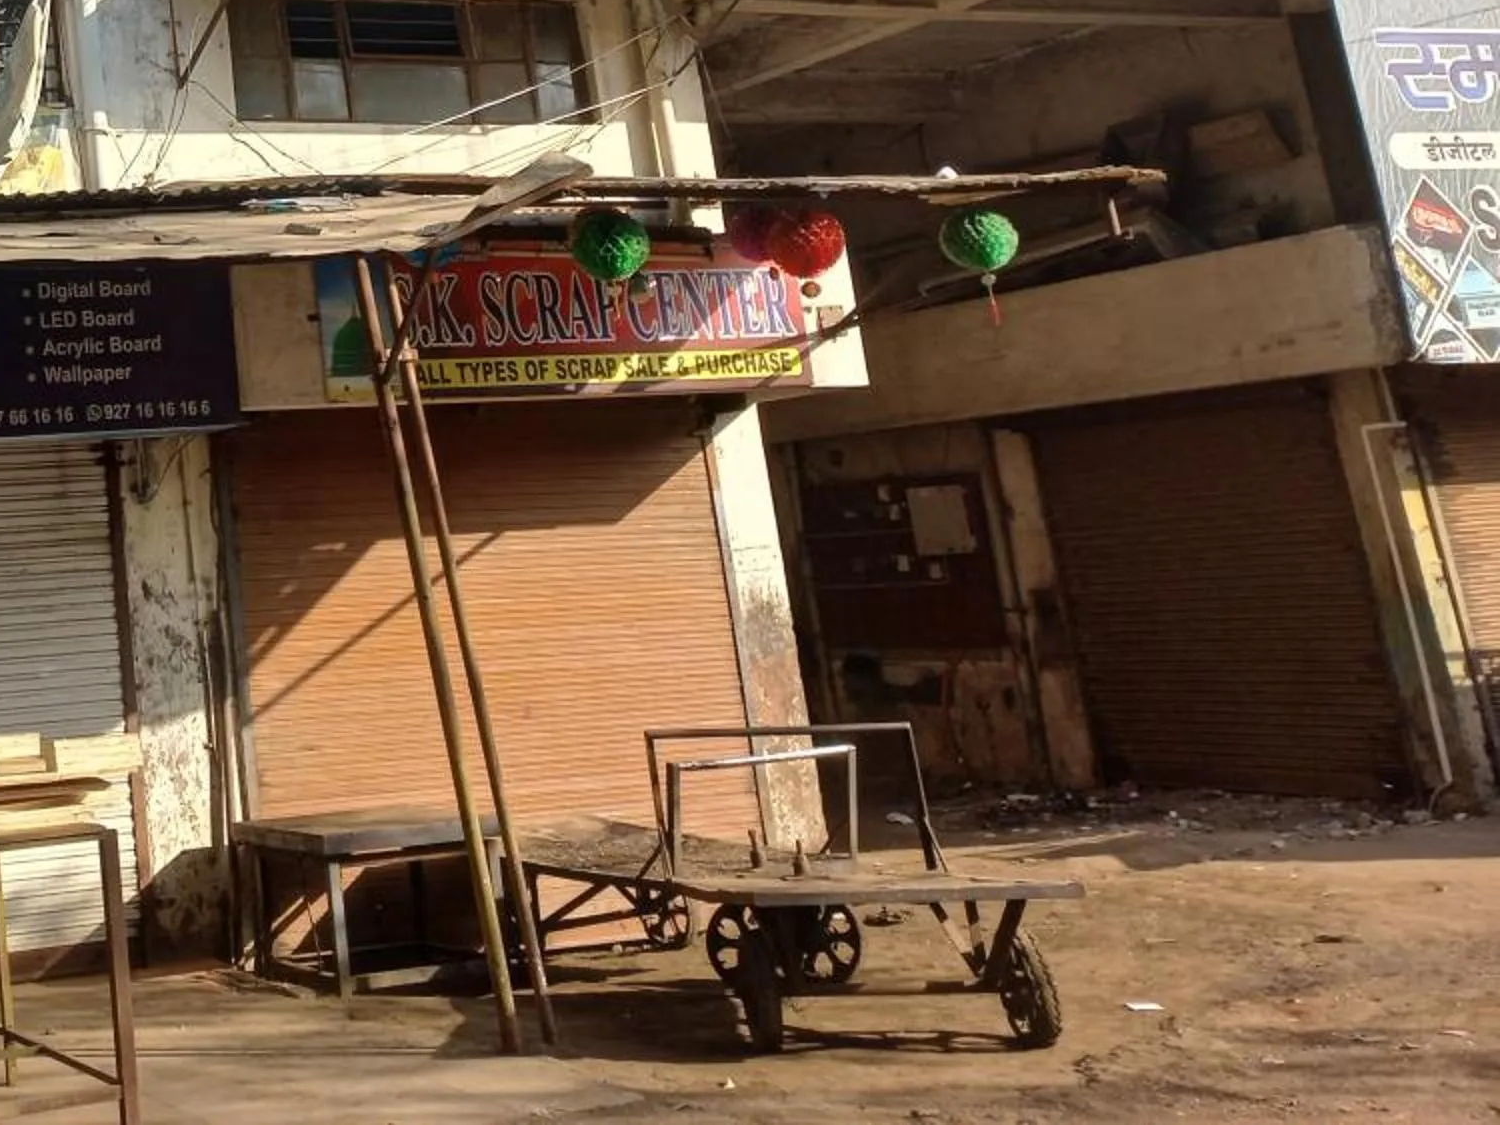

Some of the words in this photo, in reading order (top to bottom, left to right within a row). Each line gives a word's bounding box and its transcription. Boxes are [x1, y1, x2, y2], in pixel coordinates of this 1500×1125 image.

[37, 282, 95, 303] Digital
[99, 279, 152, 298] Board
[624, 267, 798, 343] CENTER
[39, 311, 76, 329] LED
[82, 308, 136, 328] Board
[42, 336, 105, 358] Acrylic
[109, 334, 163, 354] Board
[43, 364, 133, 386] Wallpaper
[416, 361, 452, 385] ALL
[456, 357, 518, 384] TYPES
[524, 358, 550, 380] OF
[555, 354, 619, 380] SCRAP
[624, 353, 671, 377] SALE
[676, 354, 691, 375] &
[695, 350, 793, 376] PURCHASE
